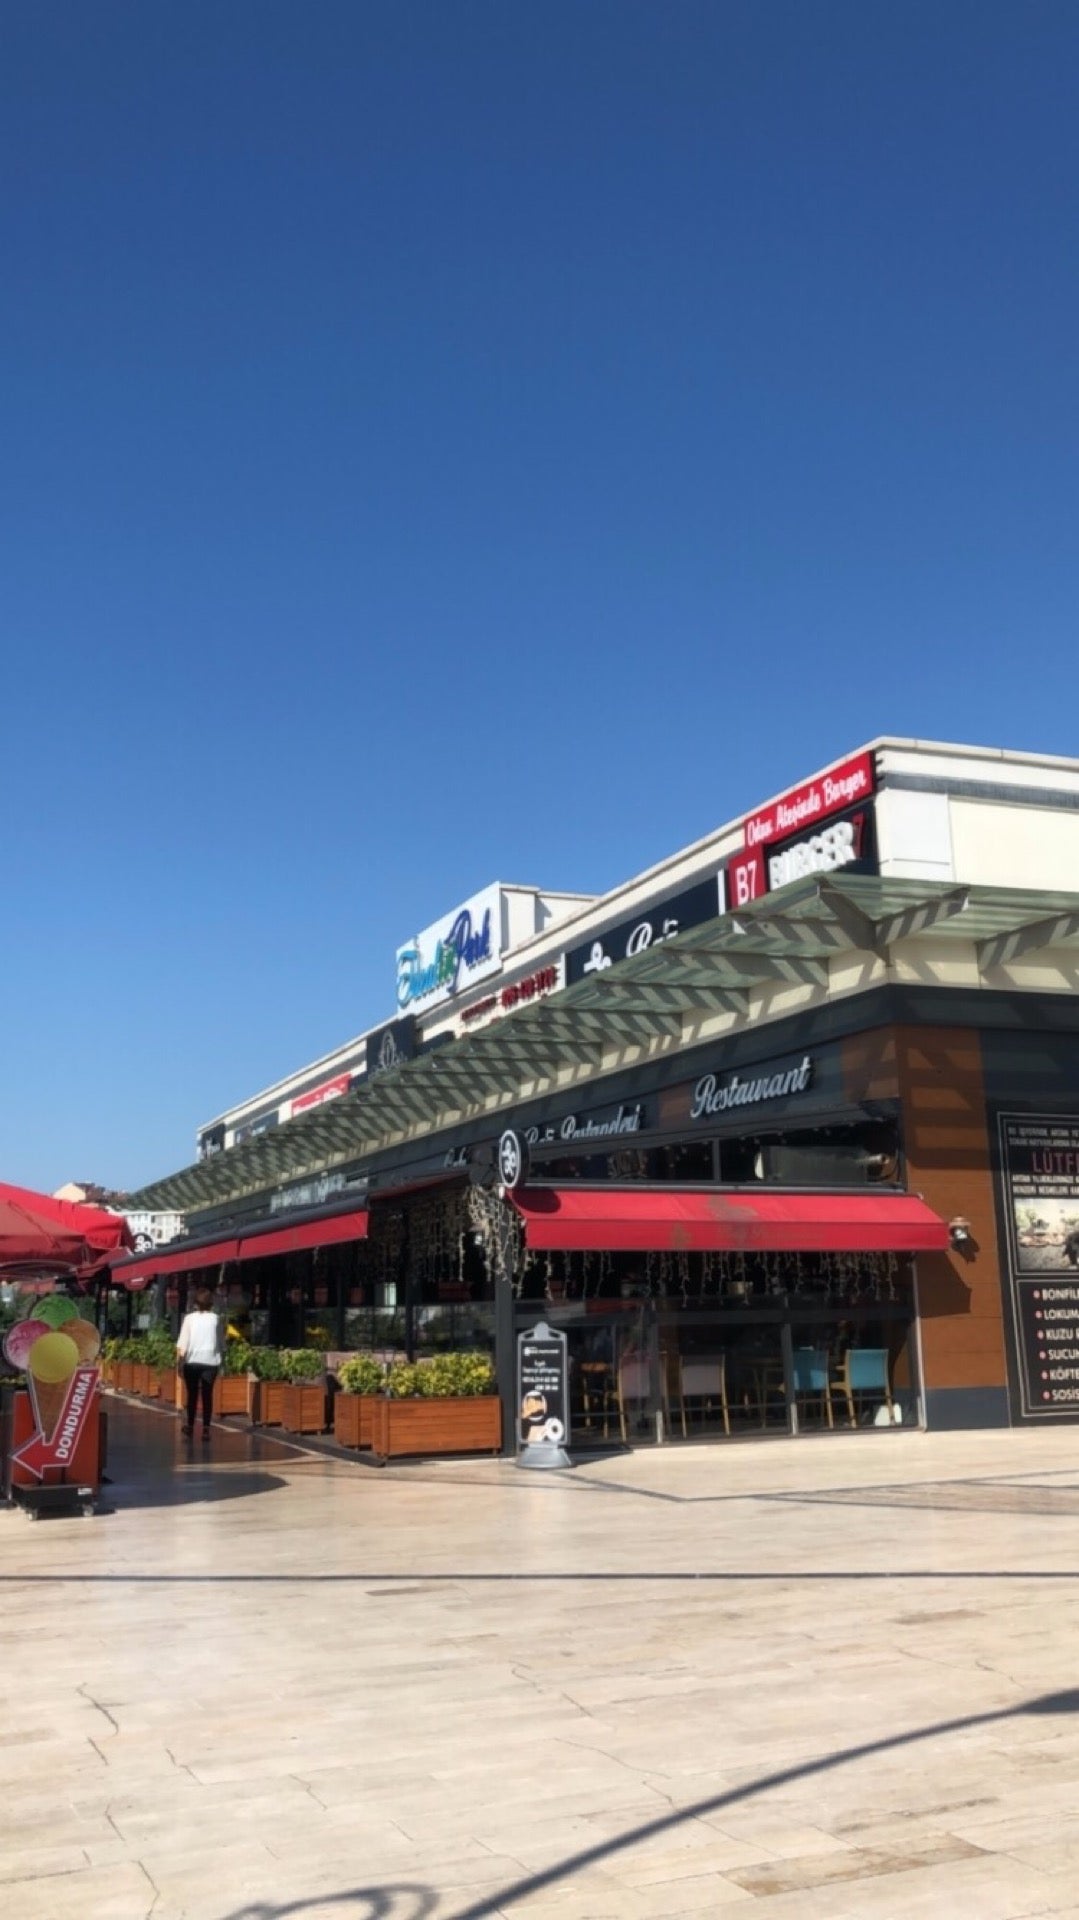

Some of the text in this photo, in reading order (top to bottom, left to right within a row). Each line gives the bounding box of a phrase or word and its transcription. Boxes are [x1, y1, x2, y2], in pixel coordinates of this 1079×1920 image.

[736, 861, 757, 905] B7
[690, 1055, 811, 1119] Restaurant
[1032, 1148, 1079, 1174] LÜTF
[1044, 1308, 1079, 1321] LOKUM
[1046, 1327, 1074, 1341] KUZU
[55, 1372, 94, 1459] DONDURMA
